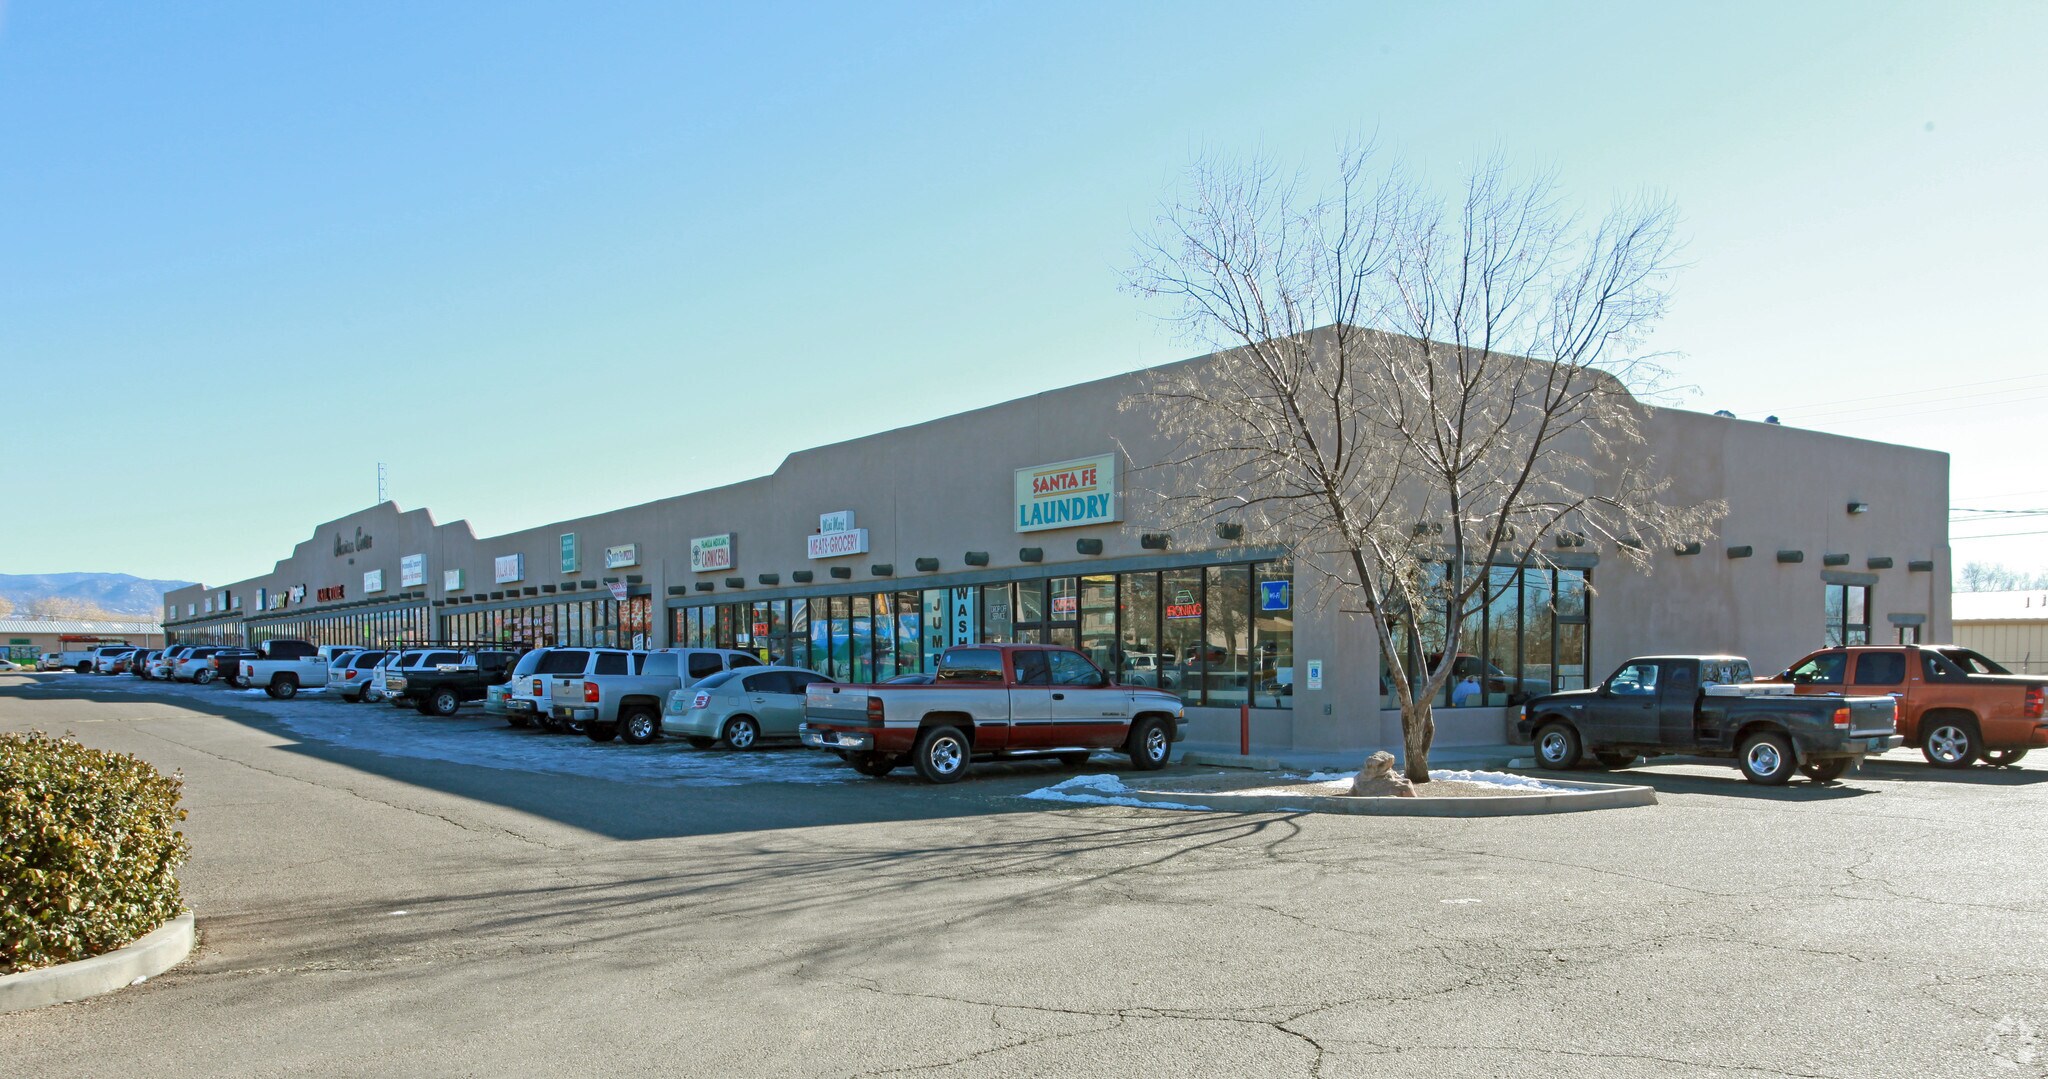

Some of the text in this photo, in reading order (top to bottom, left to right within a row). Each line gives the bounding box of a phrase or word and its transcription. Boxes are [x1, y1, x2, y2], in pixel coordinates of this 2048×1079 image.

[1033, 468, 1097, 494] SANTA FE
[1020, 493, 1110, 527] LAUNDRY
[701, 547, 730, 568] CARNICERIA
[956, 587, 968, 645] WASH
[1026, 611, 1033, 619] 21
[1167, 603, 1202, 616] IRONING
